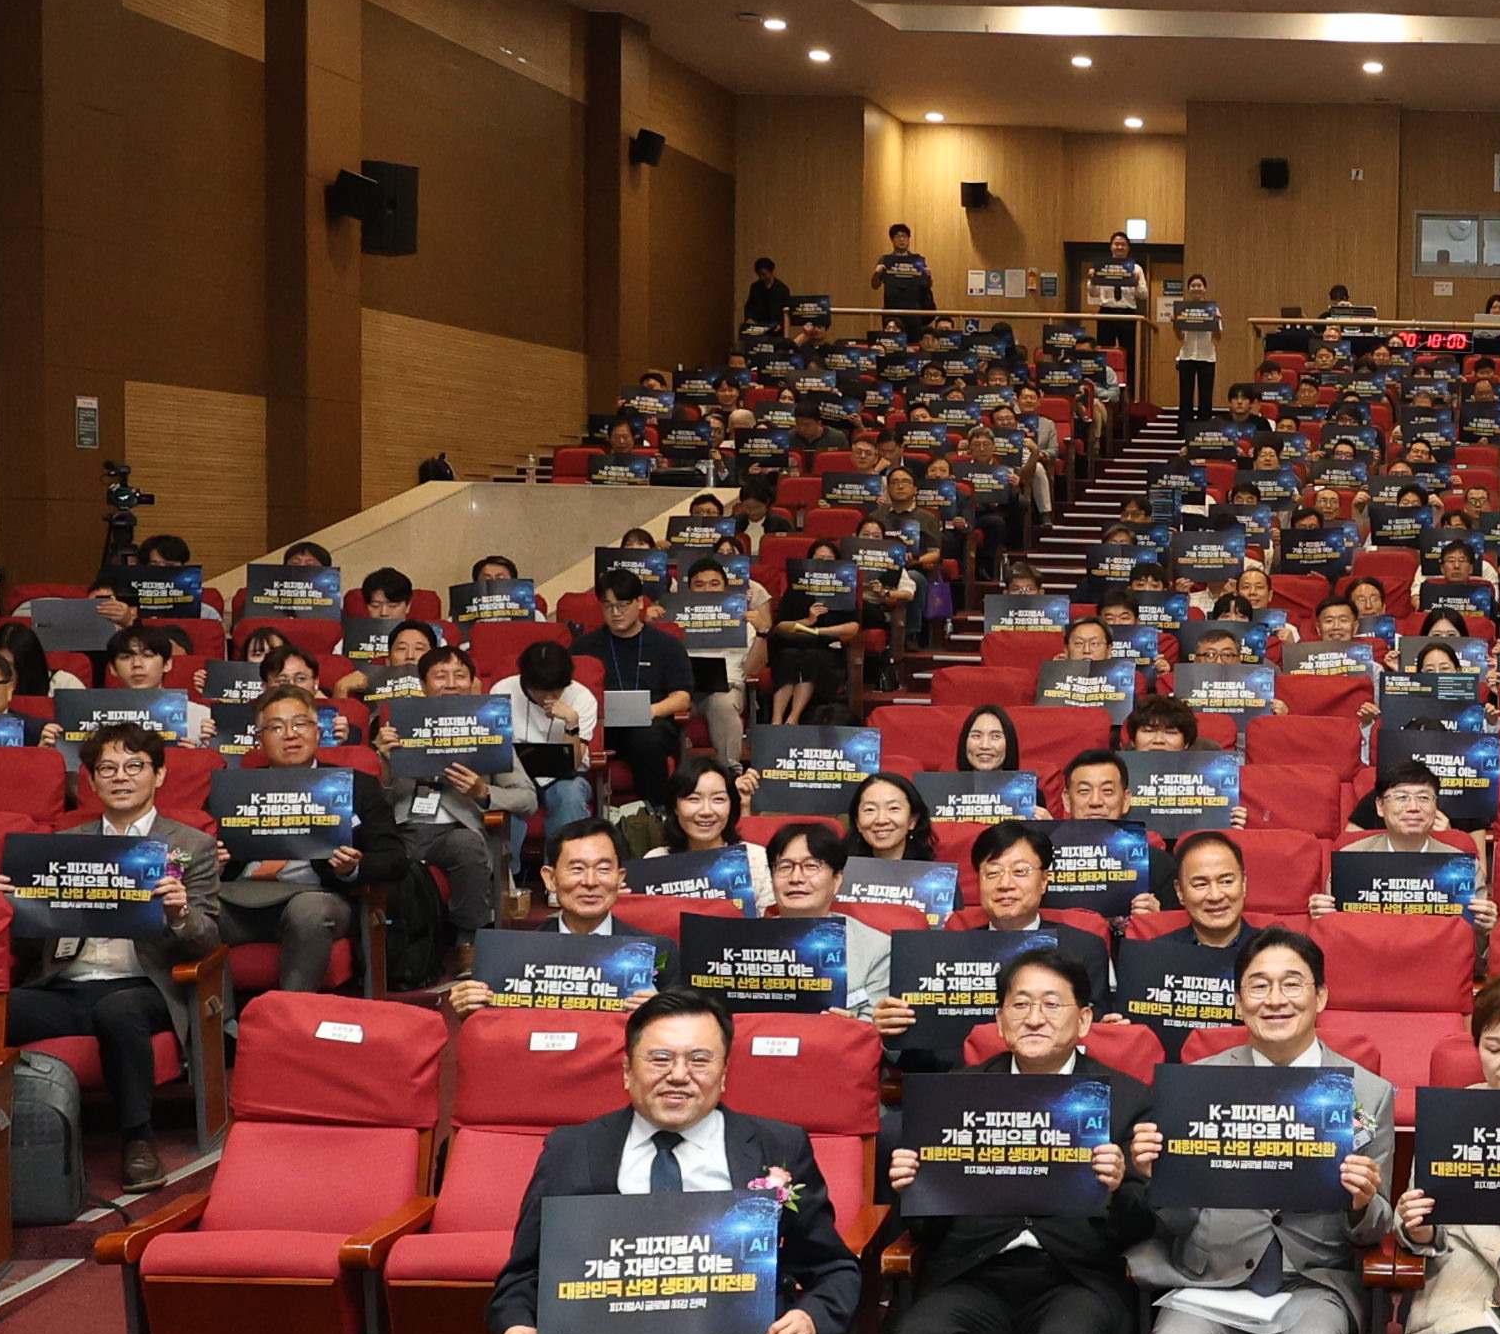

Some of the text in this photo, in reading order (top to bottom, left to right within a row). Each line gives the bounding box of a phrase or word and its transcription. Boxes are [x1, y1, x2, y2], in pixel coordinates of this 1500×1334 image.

[610, 1235, 710, 1256] K-피지컬AI
[585, 1255, 733, 1278] 기술 자립으로 여는
[558, 1281, 622, 1299] 대한민국
[626, 1278, 657, 1297] 산업
[660, 1276, 707, 1294] 생태계
